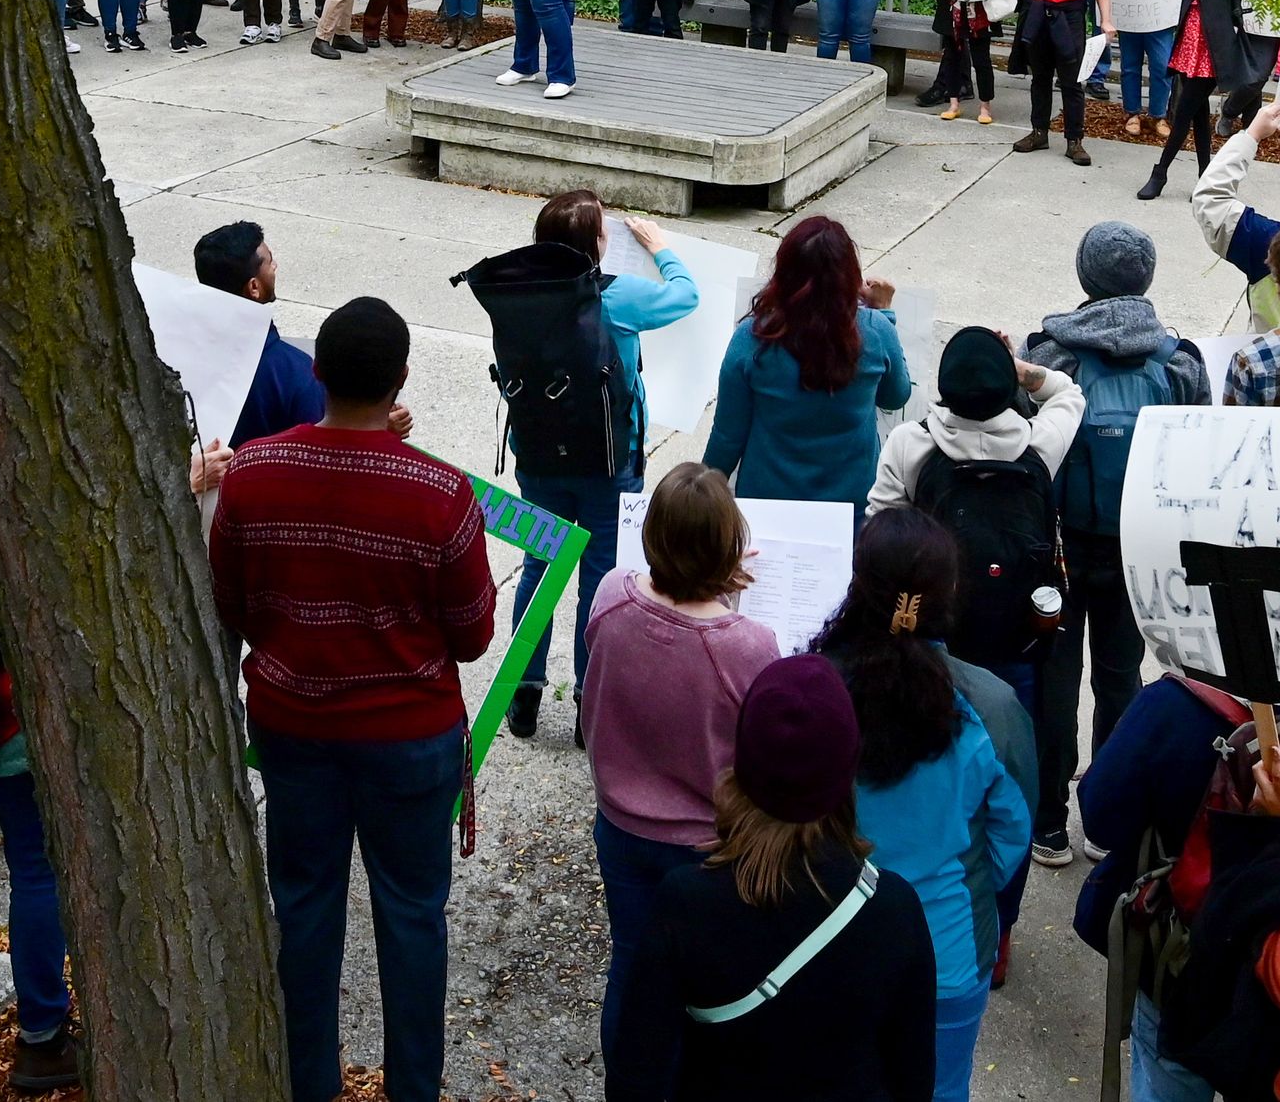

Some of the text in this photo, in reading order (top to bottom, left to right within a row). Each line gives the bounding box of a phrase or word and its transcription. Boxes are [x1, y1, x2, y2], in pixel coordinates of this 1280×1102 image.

[1112, 1, 1161, 18] ESERVE
[622, 497, 647, 513] WS
[478, 487, 570, 562] WITH
